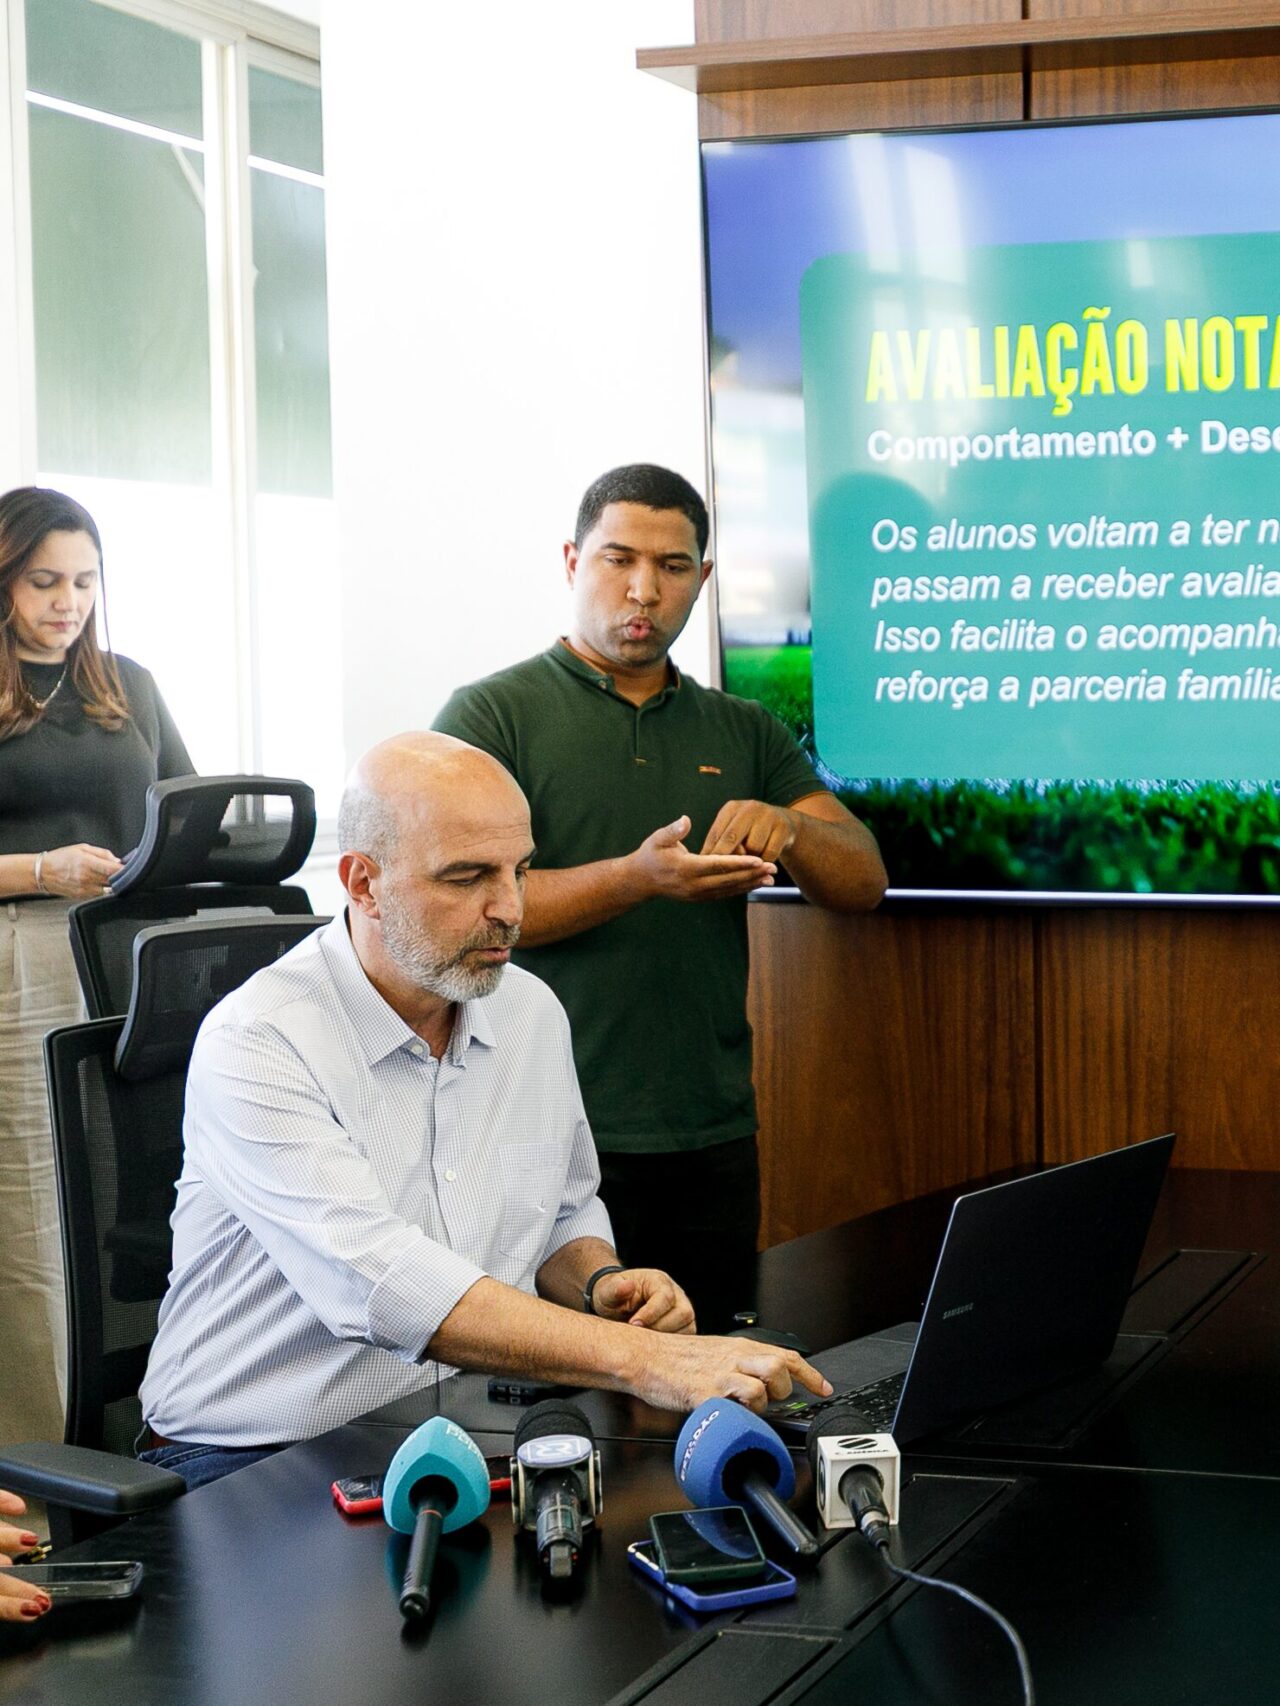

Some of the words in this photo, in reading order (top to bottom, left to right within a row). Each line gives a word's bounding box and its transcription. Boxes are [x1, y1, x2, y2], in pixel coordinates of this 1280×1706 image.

[866, 306, 1148, 416] AVALIAÇÃO
[867, 423, 1156, 467] Comportamento
[1166, 426, 1189, 448] +
[871, 518, 917, 552] Os
[928, 516, 1036, 551] alunos
[1048, 515, 1158, 548] voltam
[1169, 522, 1189, 546] a
[1201, 514, 1250, 545] ter
[871, 574, 1000, 607] passam
[1010, 574, 1030, 601] a
[1042, 568, 1174, 600] receber
[875, 620, 940, 652] Isso
[951, 618, 1054, 652] facilita
[1066, 626, 1086, 650] o
[876, 670, 989, 709] reforça
[999, 677, 1019, 701] a
[1029, 670, 1166, 706] parceria
[942, 1302, 975, 1320] SAMSUNG
